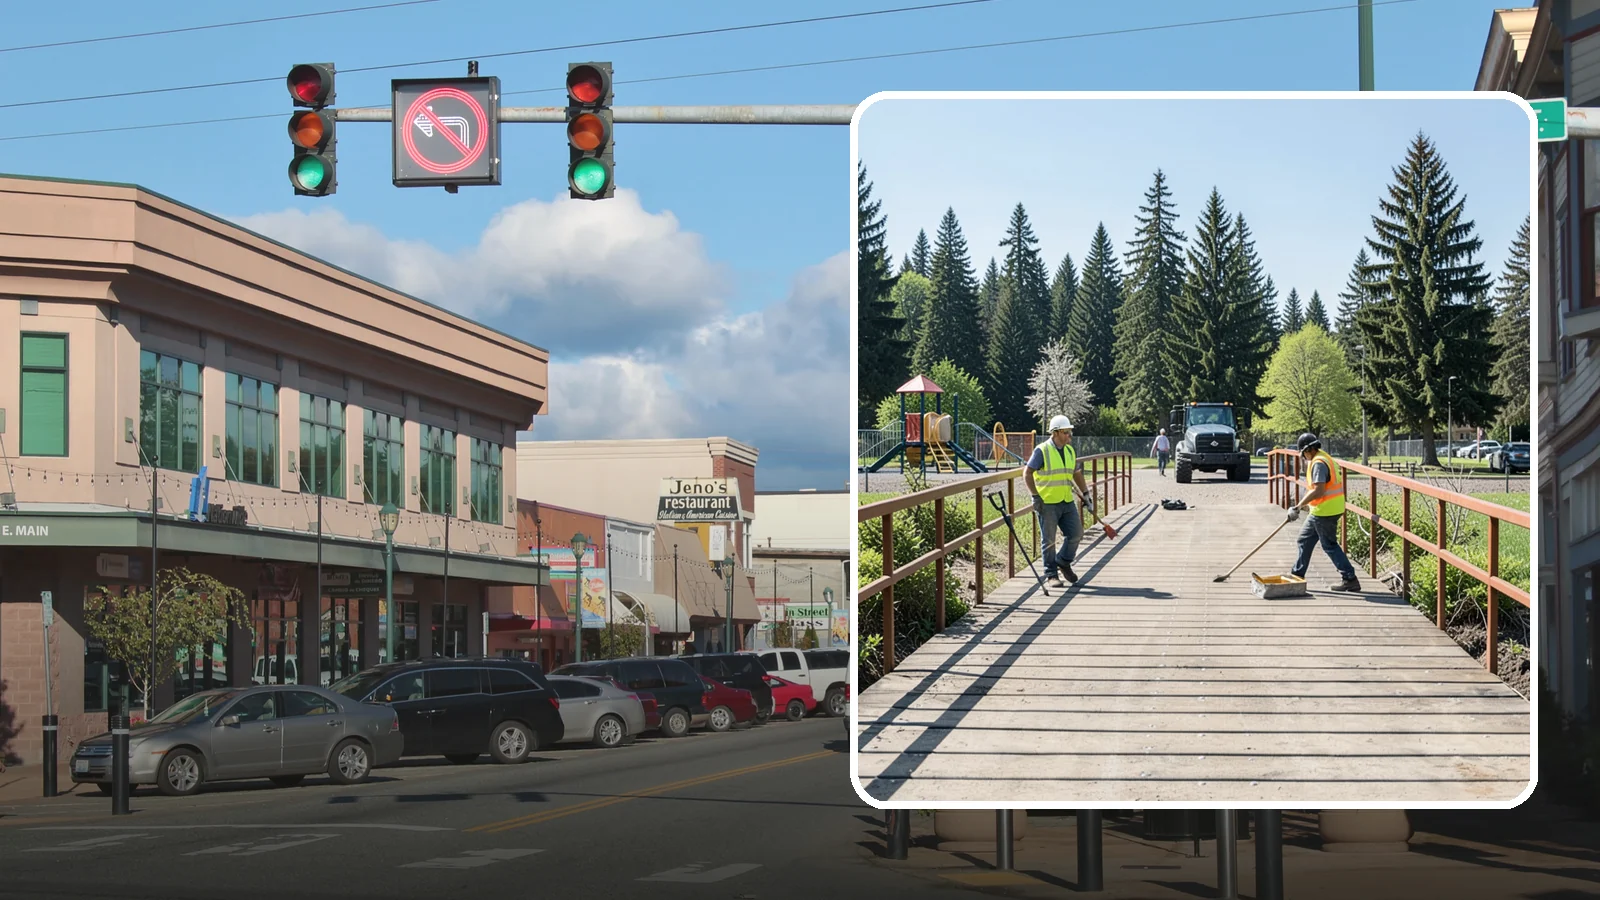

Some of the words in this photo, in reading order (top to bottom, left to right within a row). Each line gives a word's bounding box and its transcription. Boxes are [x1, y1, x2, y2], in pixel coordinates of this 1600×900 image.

[669, 480, 728, 495] Jeno's
[665, 496, 731, 509] restaurant
[658, 510, 682, 520] Italian
[686, 509, 715, 520] American
[715, 509, 738, 519] Cuisine
[2, 525, 13, 536] E.
[15, 525, 49, 536] MAIN
[797, 607, 829, 617] Street
